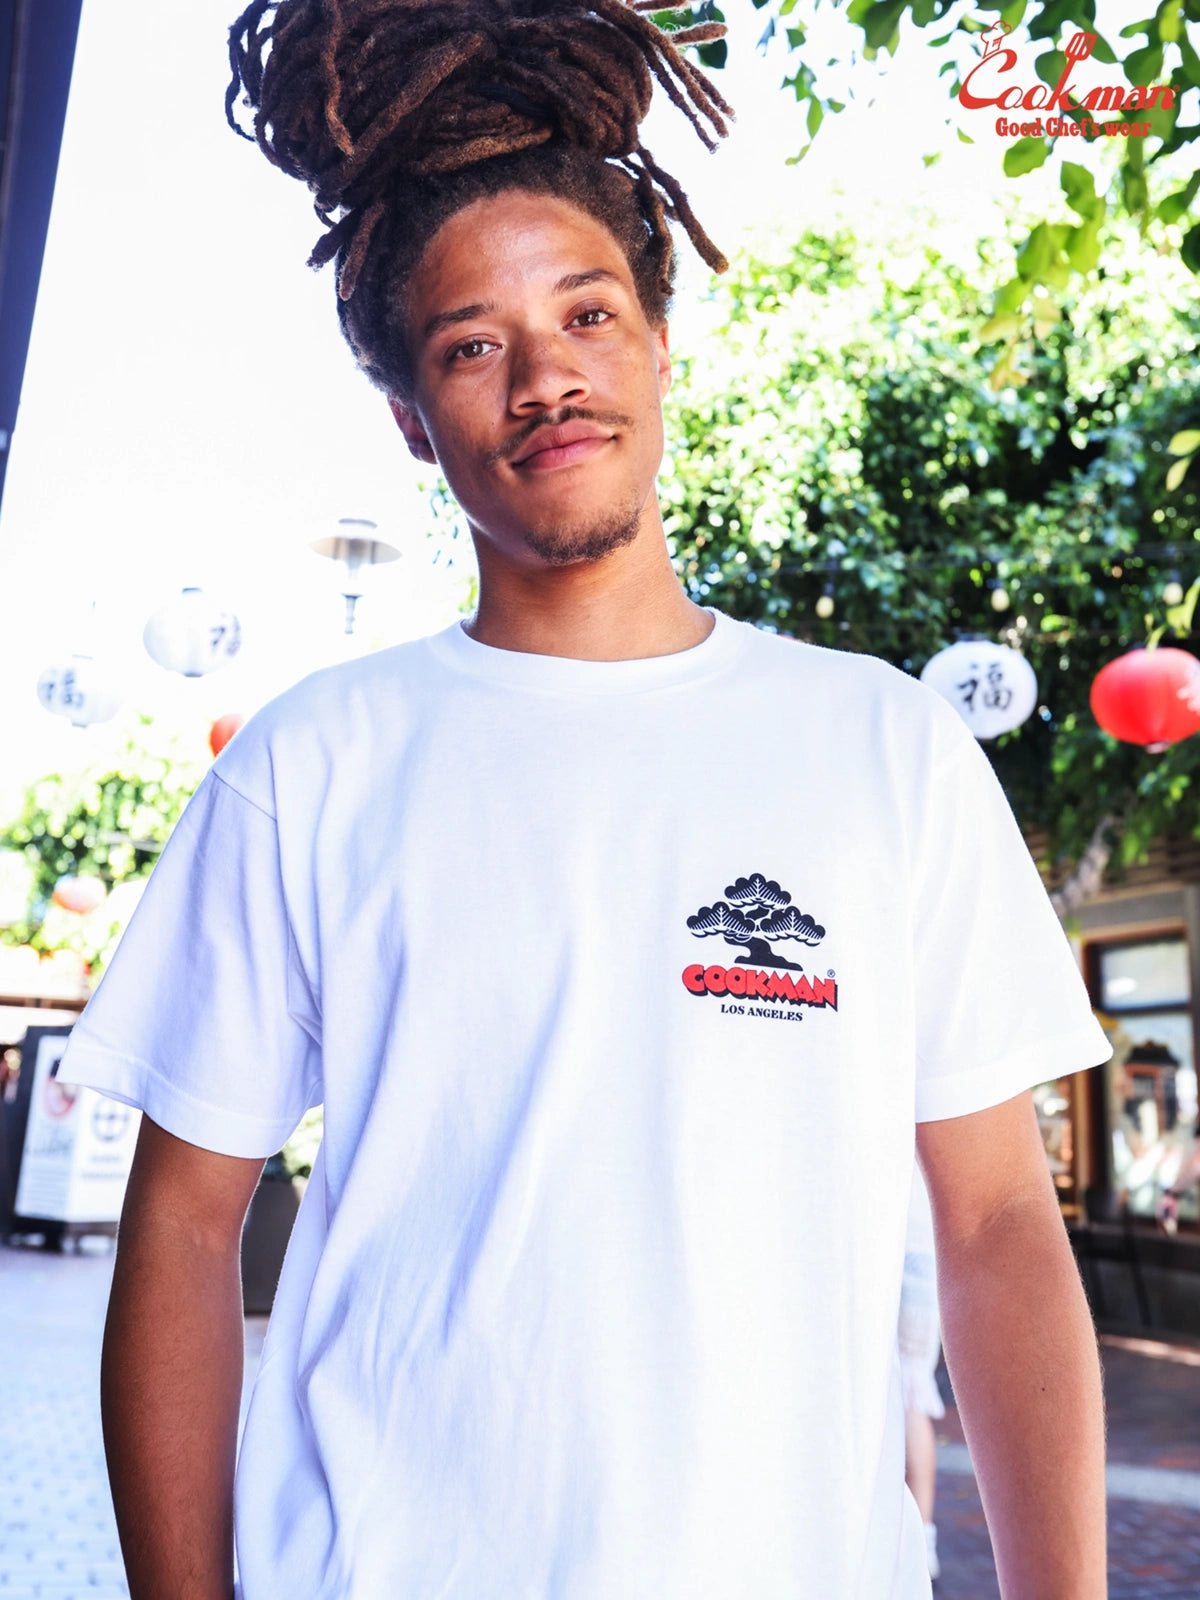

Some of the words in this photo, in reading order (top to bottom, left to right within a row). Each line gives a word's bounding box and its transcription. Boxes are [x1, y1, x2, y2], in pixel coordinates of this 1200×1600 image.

[682, 964, 838, 1012] COOKMAN
[720, 1004, 745, 1015] LOS
[747, 1007, 803, 1021] ANGELES
